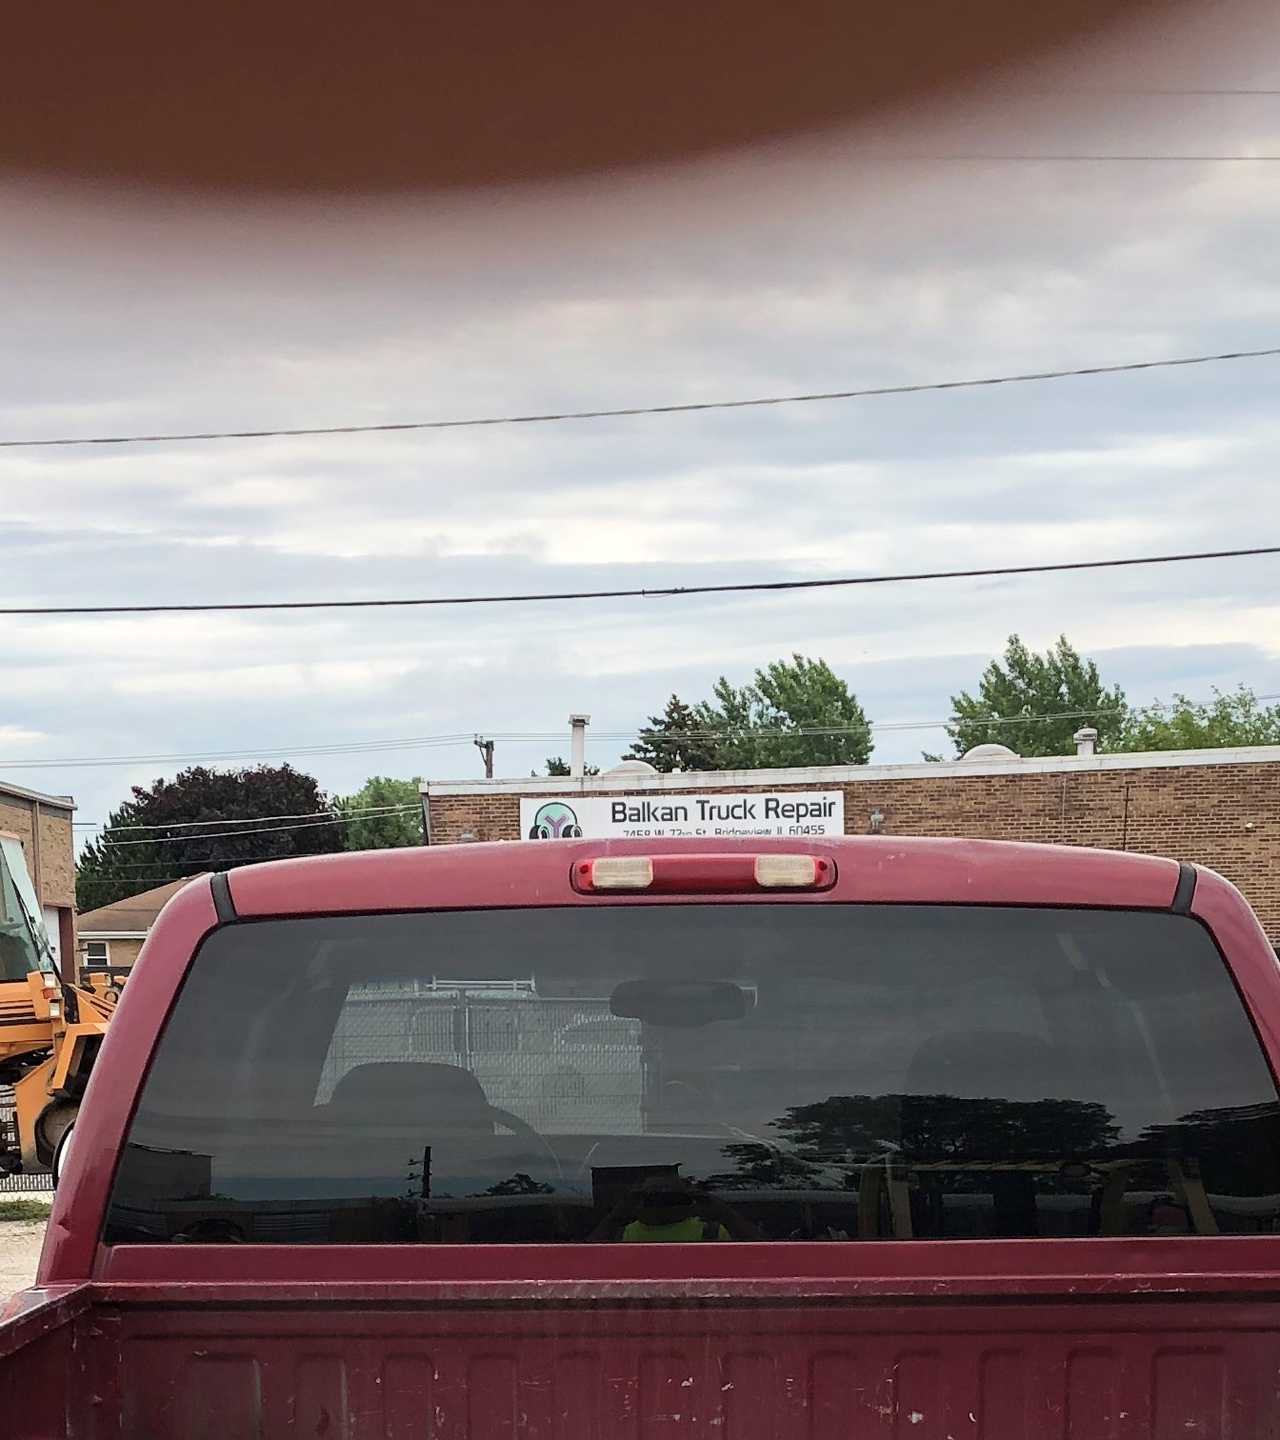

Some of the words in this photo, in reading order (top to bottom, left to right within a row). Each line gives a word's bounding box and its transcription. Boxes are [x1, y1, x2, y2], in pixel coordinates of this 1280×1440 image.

[612, 801, 688, 823] Balkan
[696, 798, 756, 821] Truck
[765, 796, 836, 823] Repair
